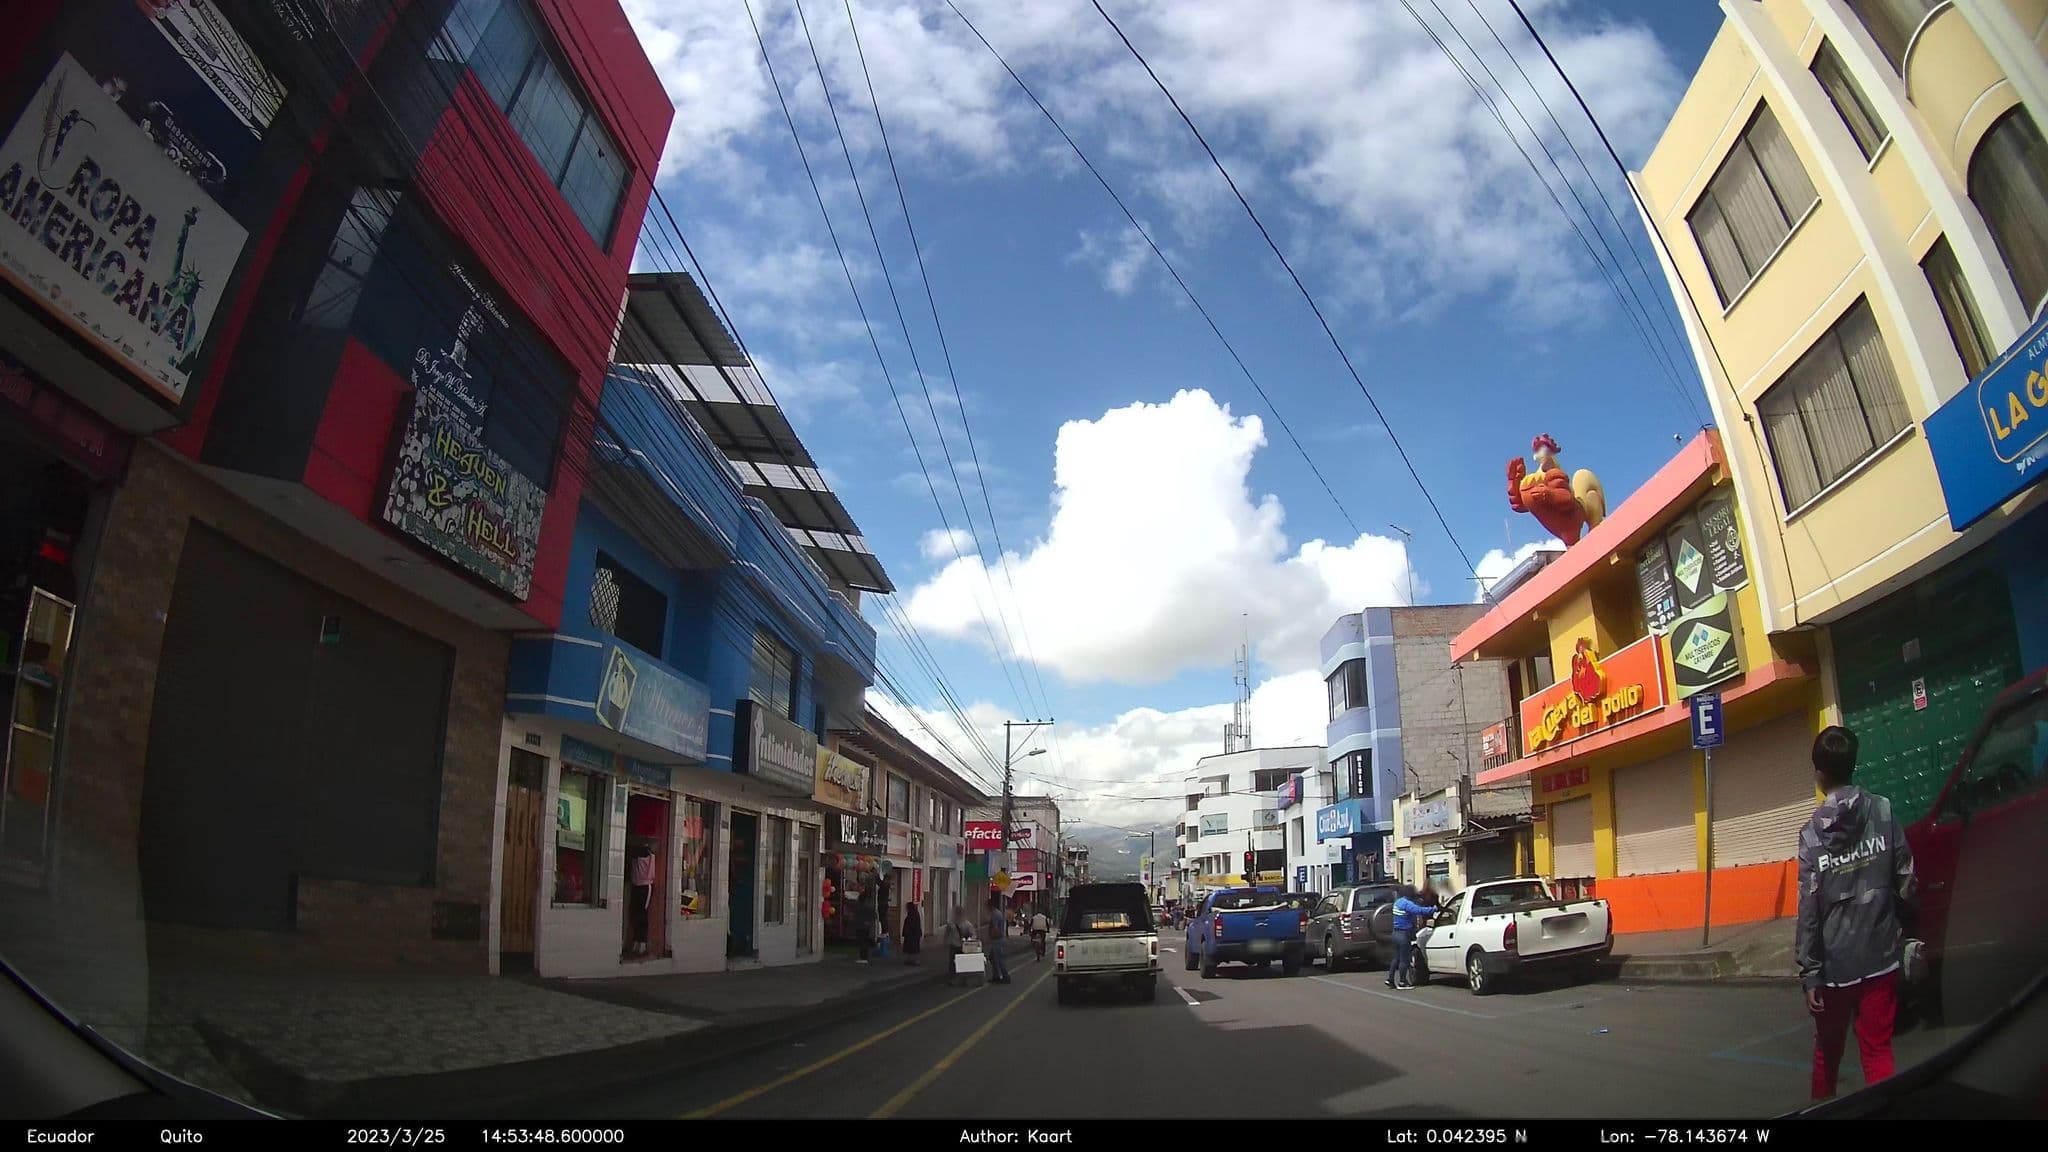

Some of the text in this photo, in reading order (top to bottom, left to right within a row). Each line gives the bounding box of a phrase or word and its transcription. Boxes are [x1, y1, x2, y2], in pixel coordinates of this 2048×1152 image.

[66, 155, 158, 263] ROPA
[0, 162, 190, 352] AMERICANA
[2027, 332, 2048, 361] ALM
[1990, 358, 2048, 440] LA G
[435, 426, 508, 499] HEAVEN
[465, 501, 518, 558] HELL
[1572, 684, 1644, 729] del pollo
[1699, 704, 1716, 735] E
